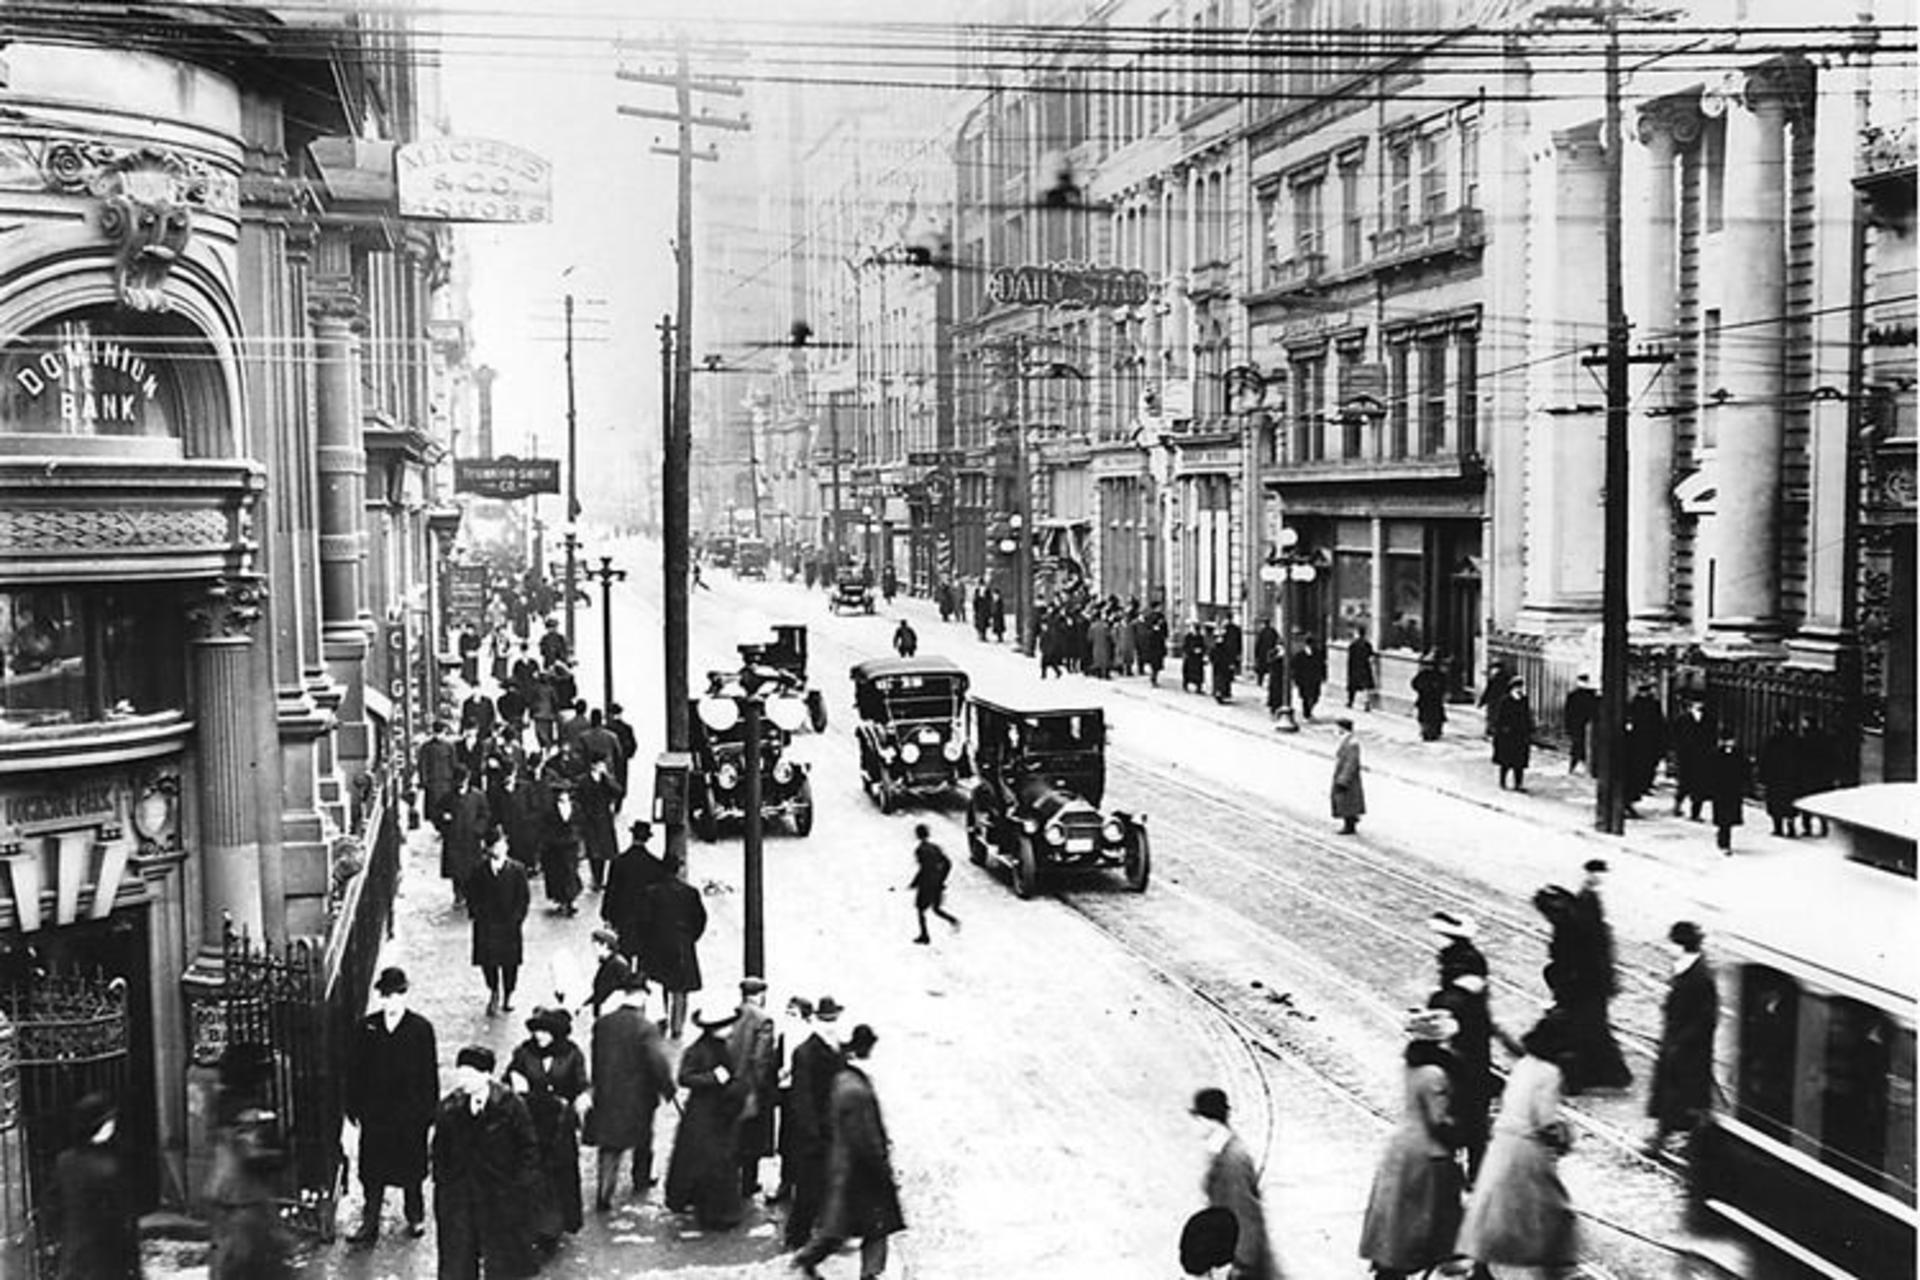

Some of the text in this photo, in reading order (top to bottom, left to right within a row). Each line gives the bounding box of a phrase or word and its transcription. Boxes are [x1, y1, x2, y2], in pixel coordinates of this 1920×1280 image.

[999, 273, 1146, 300] DAILY STAR
[17, 340, 158, 399] DOMINION
[61, 392, 136, 420] BANK
